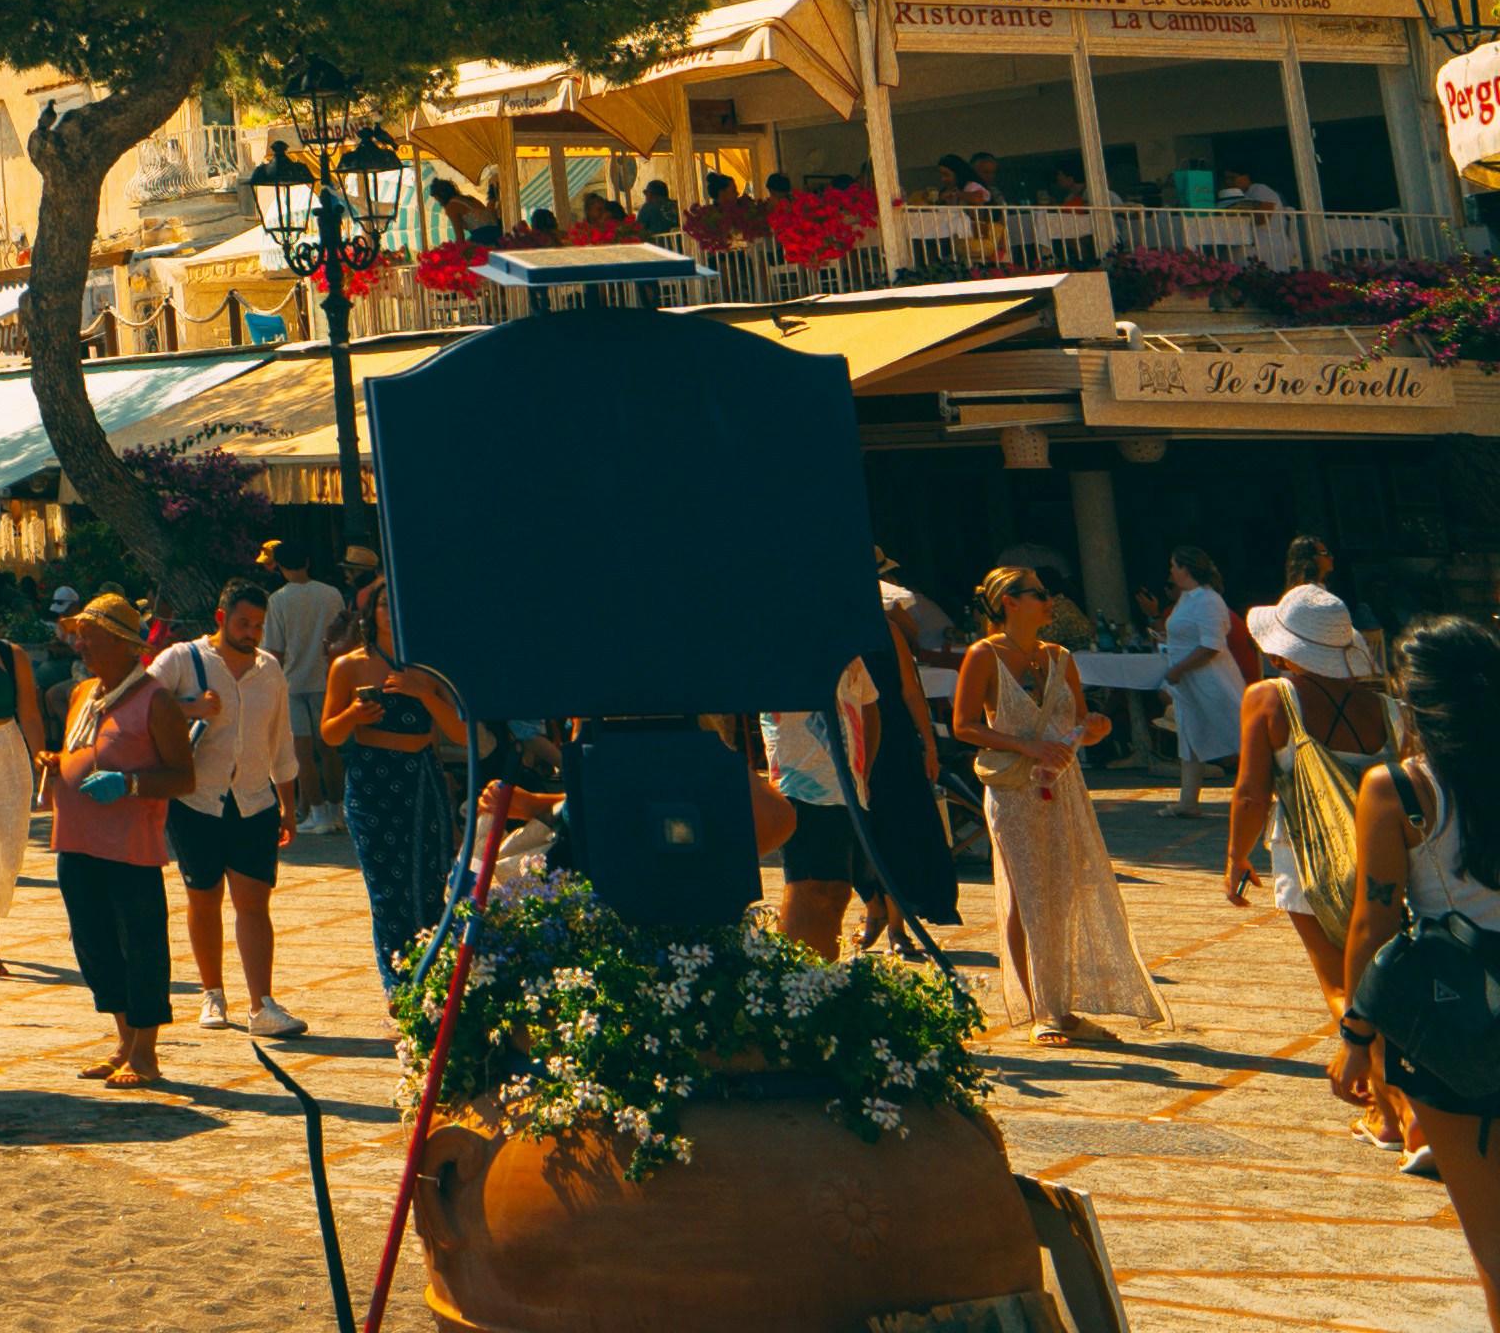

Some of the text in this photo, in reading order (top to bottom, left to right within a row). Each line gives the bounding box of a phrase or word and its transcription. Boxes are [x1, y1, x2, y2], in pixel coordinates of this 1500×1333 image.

[894, 1, 1258, 34] Ristorante La Cambusa
[1204, 360, 1428, 399] Le Tre Sorelle
